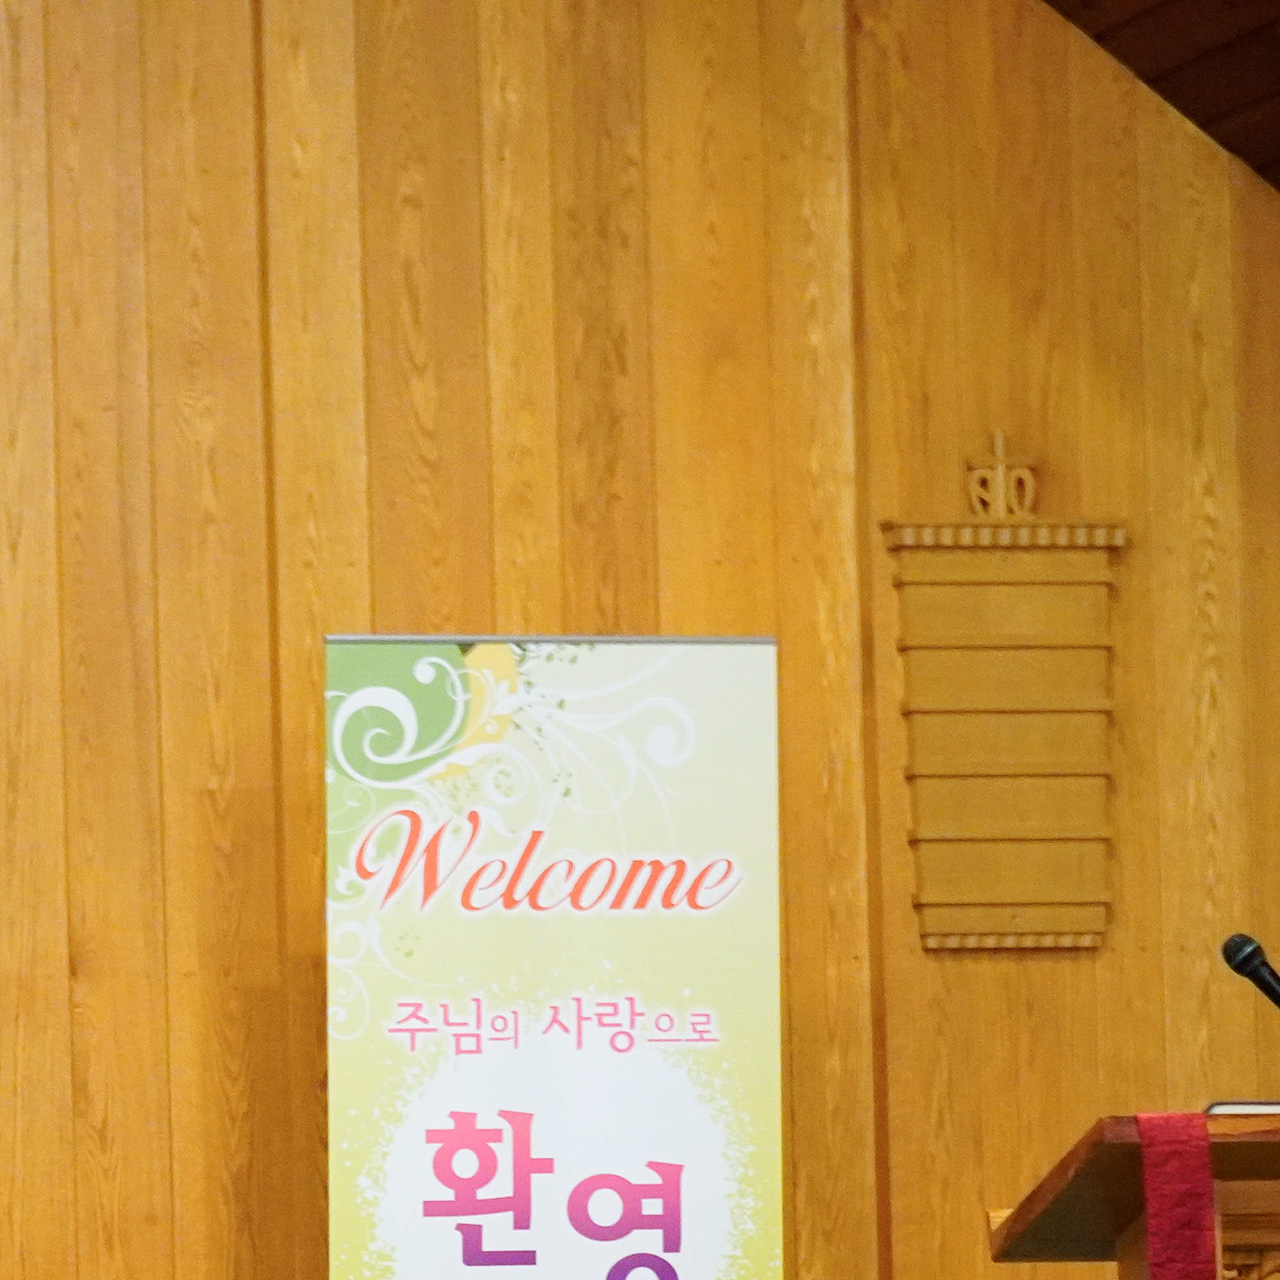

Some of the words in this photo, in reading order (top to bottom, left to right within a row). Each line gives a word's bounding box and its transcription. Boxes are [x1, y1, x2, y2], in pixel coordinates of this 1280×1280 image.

[355, 809, 743, 911] Welcome
[387, 997, 520, 1056] 주님의
[542, 996, 720, 1053] 사랑으로
